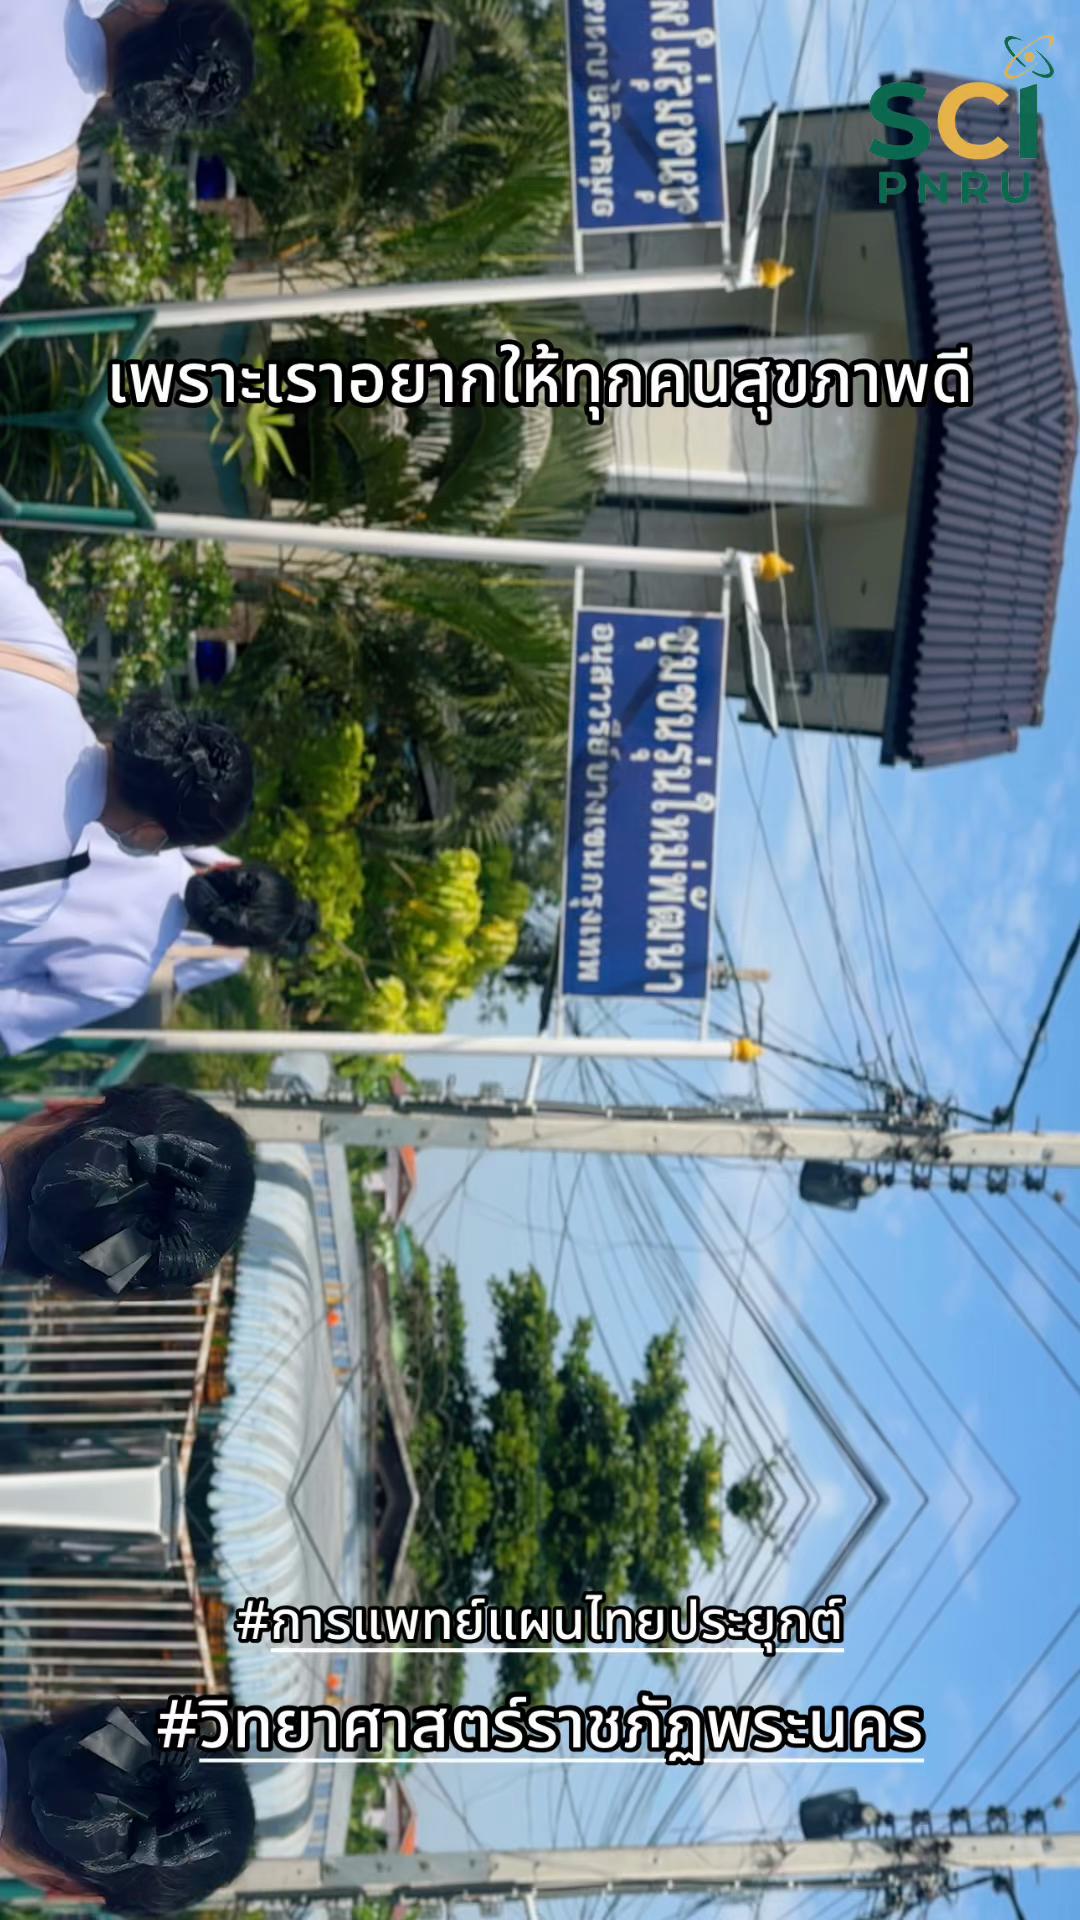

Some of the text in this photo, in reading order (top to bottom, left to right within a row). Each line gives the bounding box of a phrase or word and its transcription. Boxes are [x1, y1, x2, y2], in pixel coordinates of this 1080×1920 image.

[631, 626, 714, 993] ชุมชนรุ่นใหม่พัฒนา
